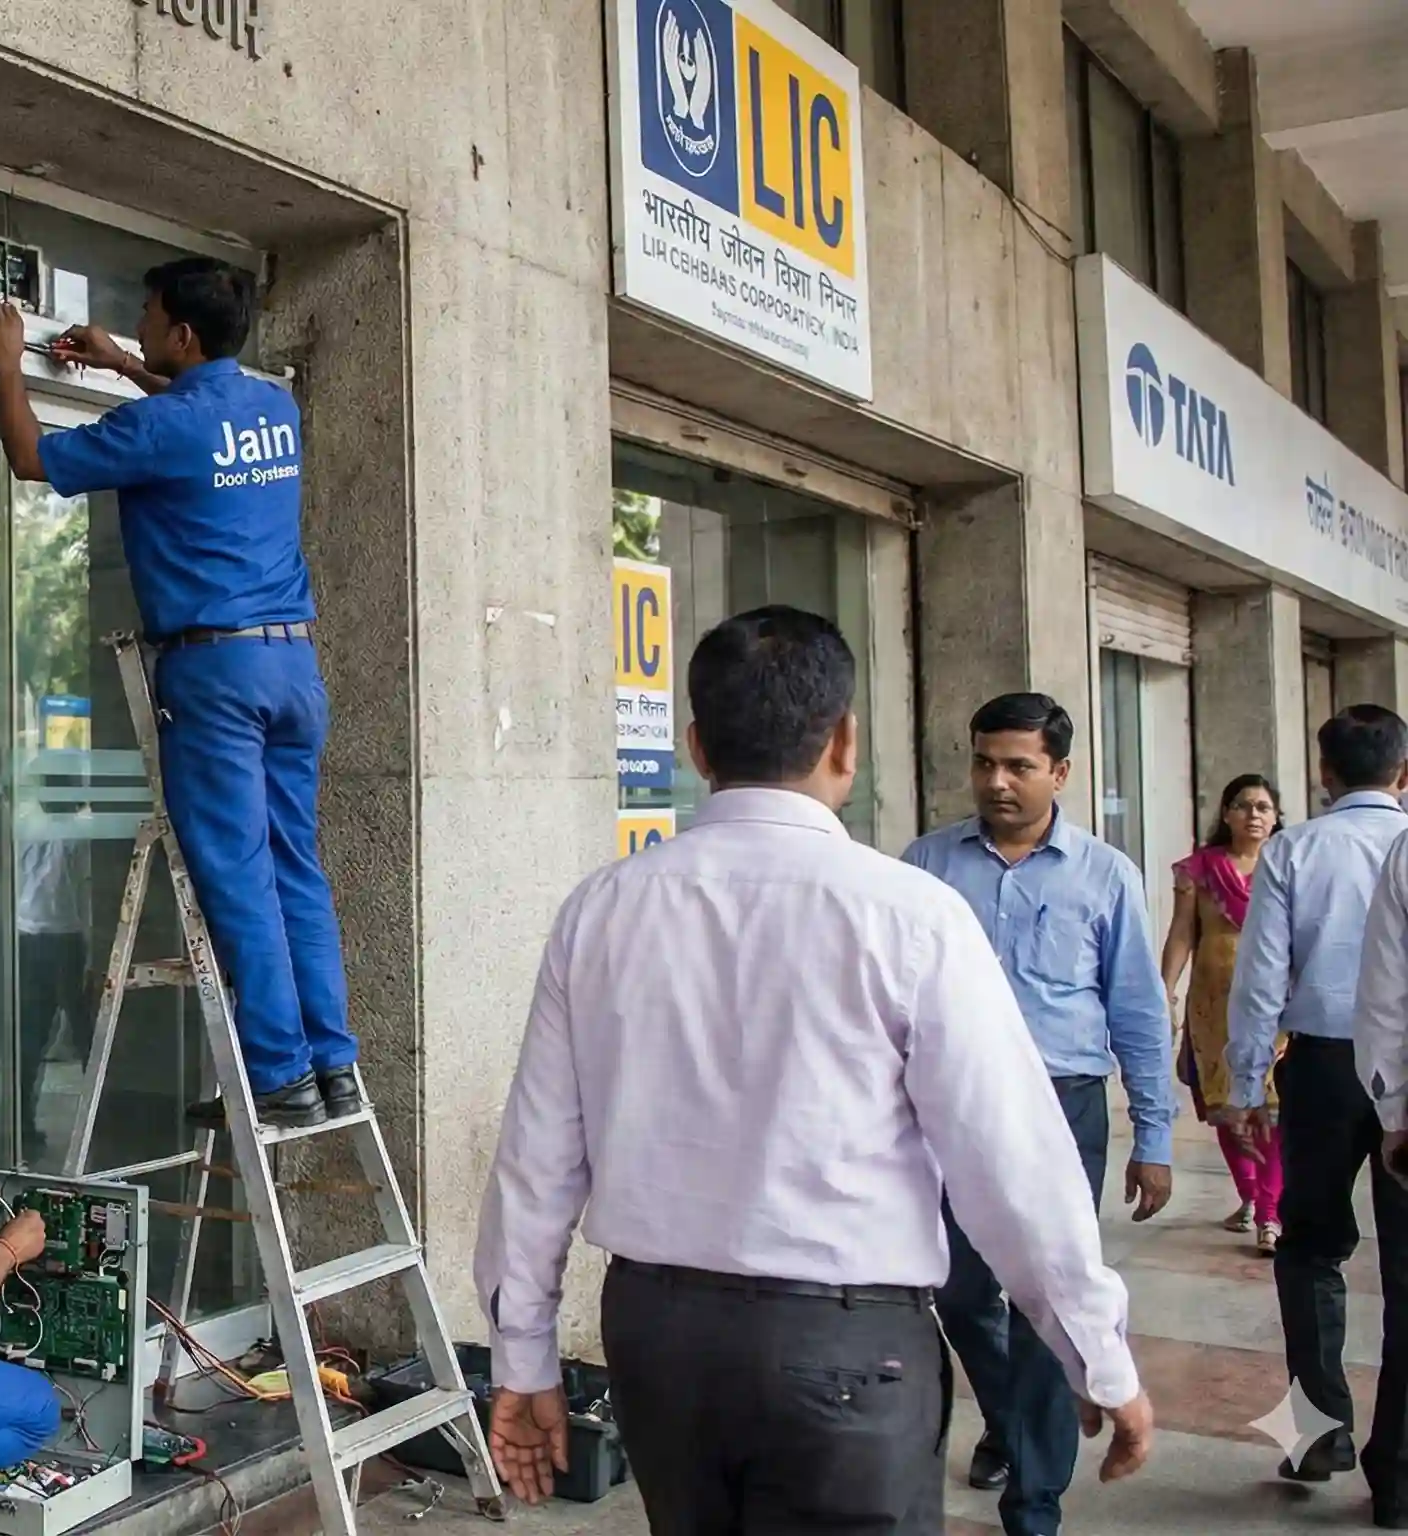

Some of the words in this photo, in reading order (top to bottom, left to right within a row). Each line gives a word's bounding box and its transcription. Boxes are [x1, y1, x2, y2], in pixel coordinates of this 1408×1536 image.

[748, 46, 845, 249] LIC
[642, 188, 710, 252] भारतीय
[212, 415, 295, 466] Jain
[1168, 373, 1236, 487] TATA
[213, 472, 248, 488] Door
[614, 583, 660, 678] IC
